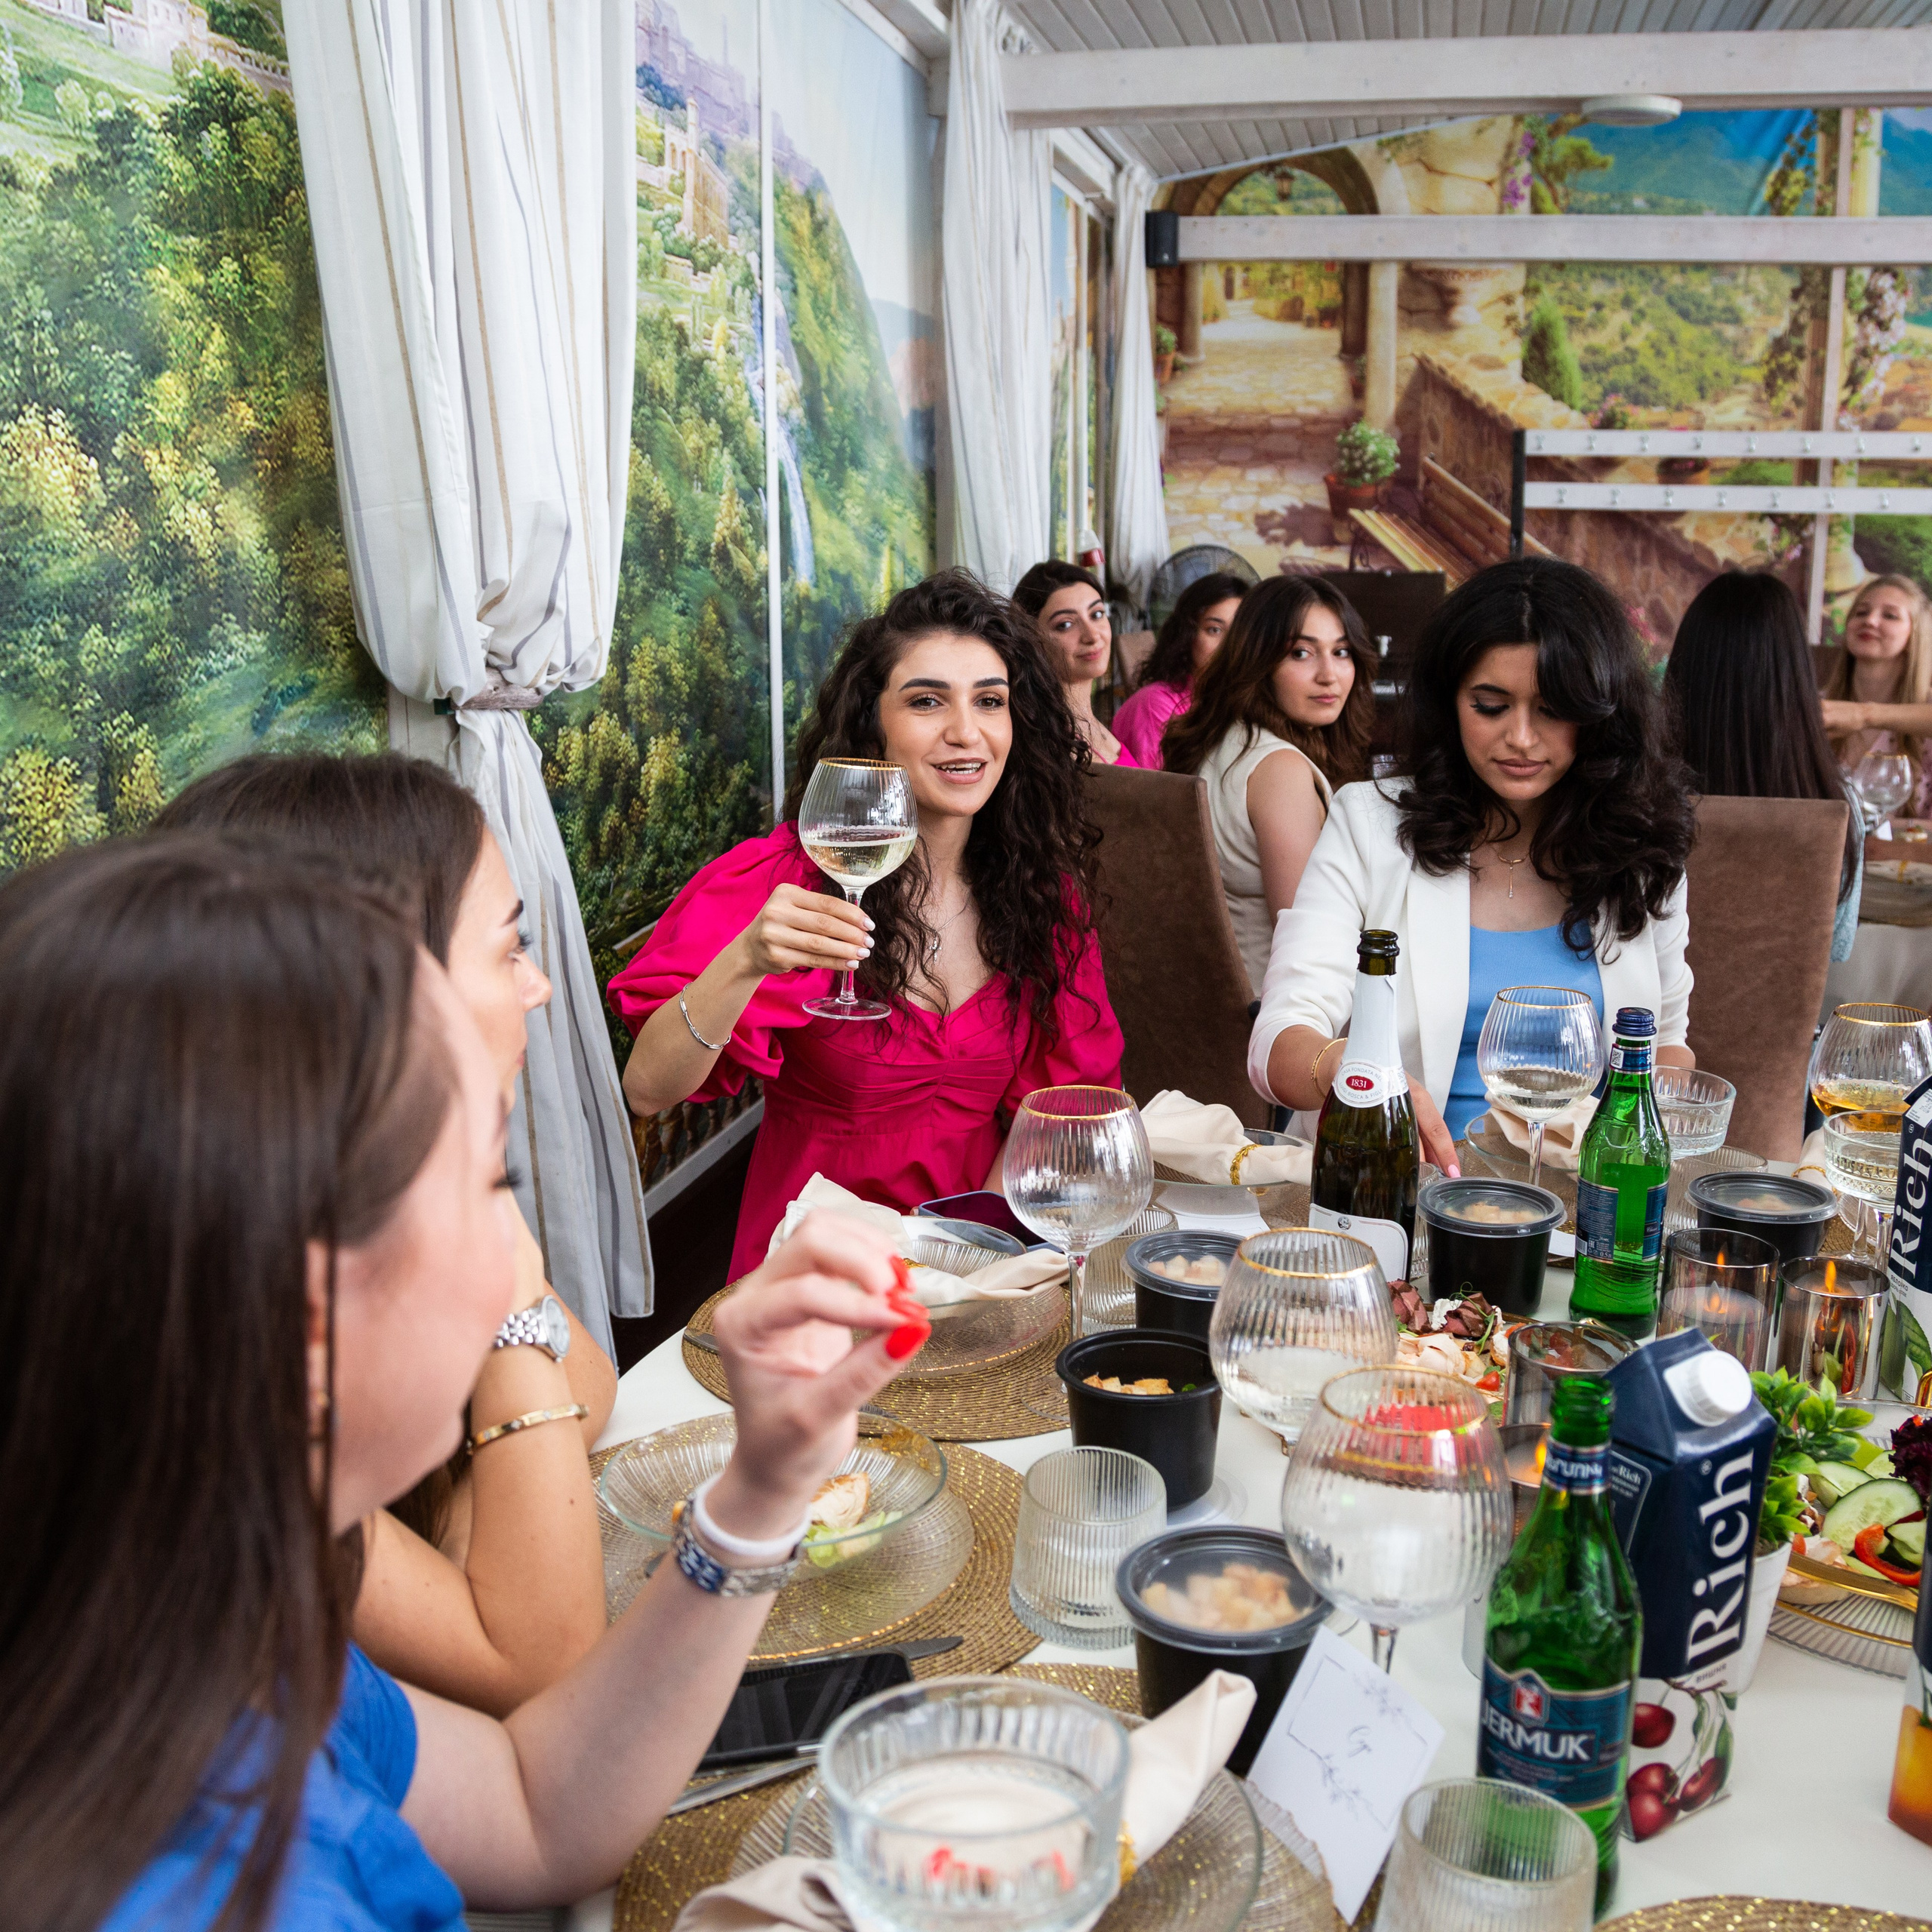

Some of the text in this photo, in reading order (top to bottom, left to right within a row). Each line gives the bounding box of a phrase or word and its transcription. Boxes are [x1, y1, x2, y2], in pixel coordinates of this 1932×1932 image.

[1352, 1067, 1374, 1075] FONDATA
[1351, 1078, 1367, 1088] 1831
[1347, 1091, 1364, 1100] BOSCA
[1890, 1138, 1932, 1279] Rich
[1619, 1464, 1641, 1484] Rich
[1686, 1447, 1755, 1665] Rich
[1482, 1700, 1590, 1761] JERMUK
